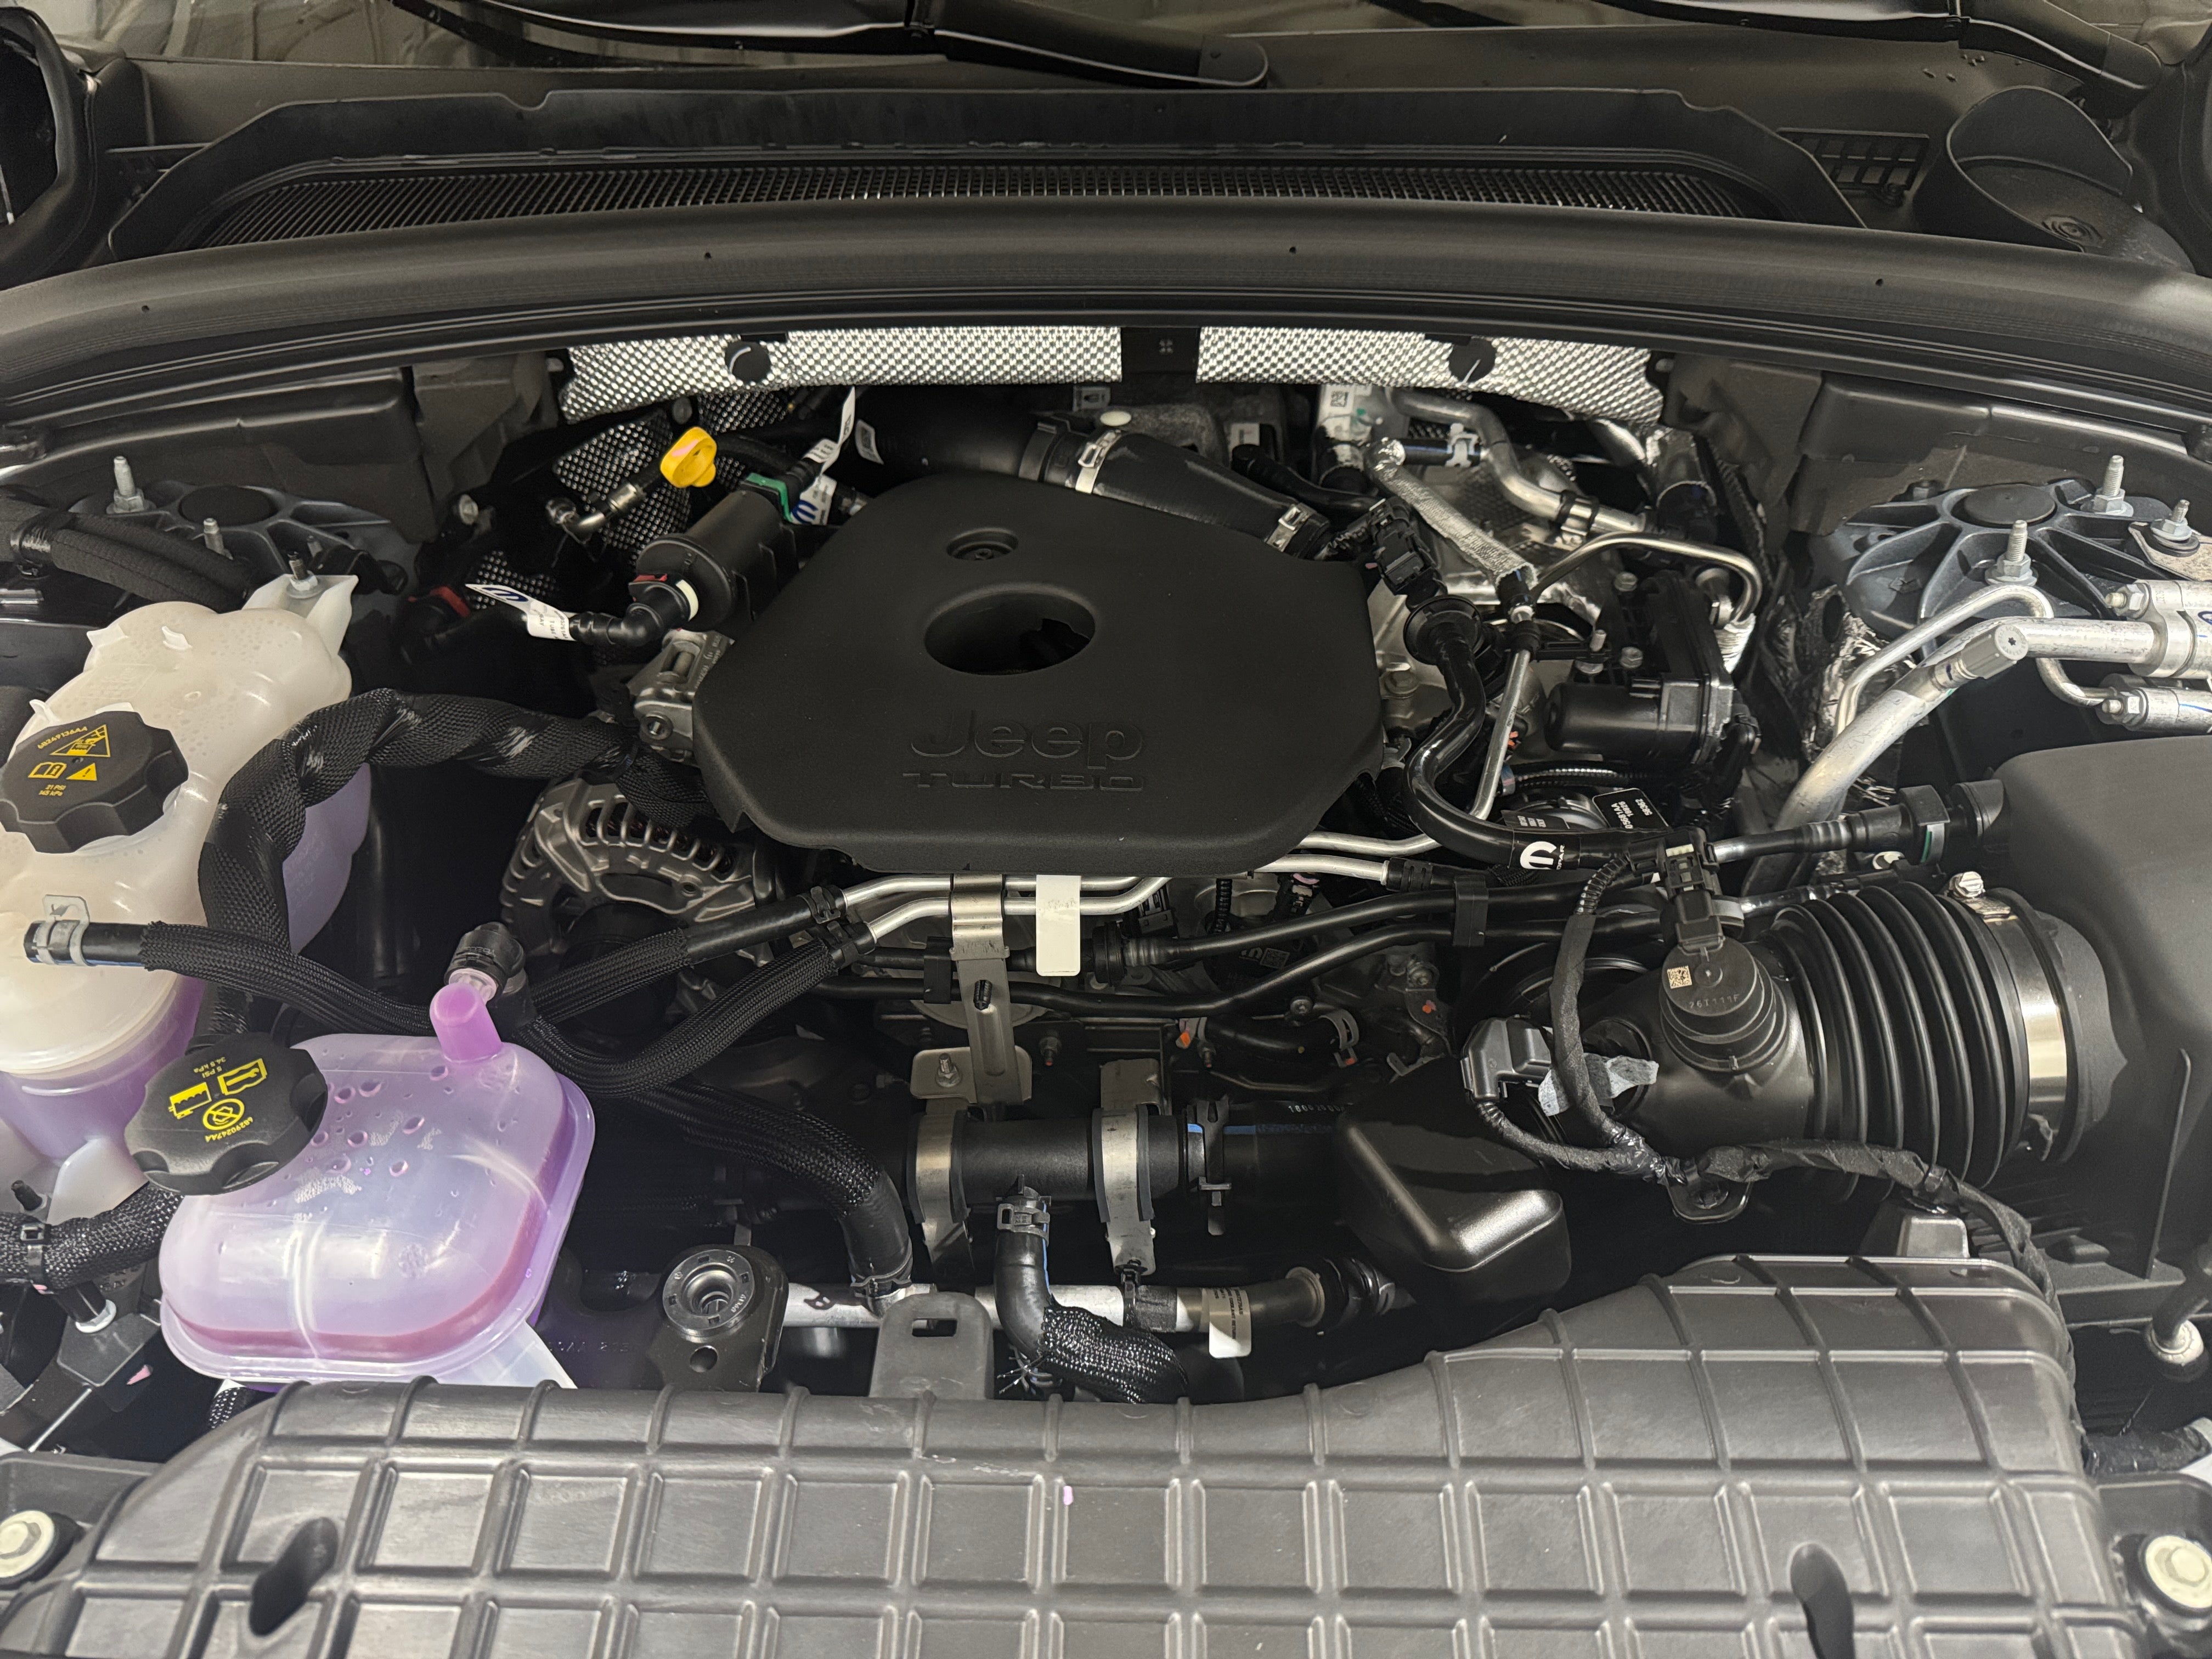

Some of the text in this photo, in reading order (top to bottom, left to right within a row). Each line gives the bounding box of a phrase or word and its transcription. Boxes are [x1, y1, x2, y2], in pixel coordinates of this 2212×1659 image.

[910, 709, 1143, 770] Jeep
[902, 772, 1144, 791] TURBO
[201, 1068, 216, 1079] PSI
